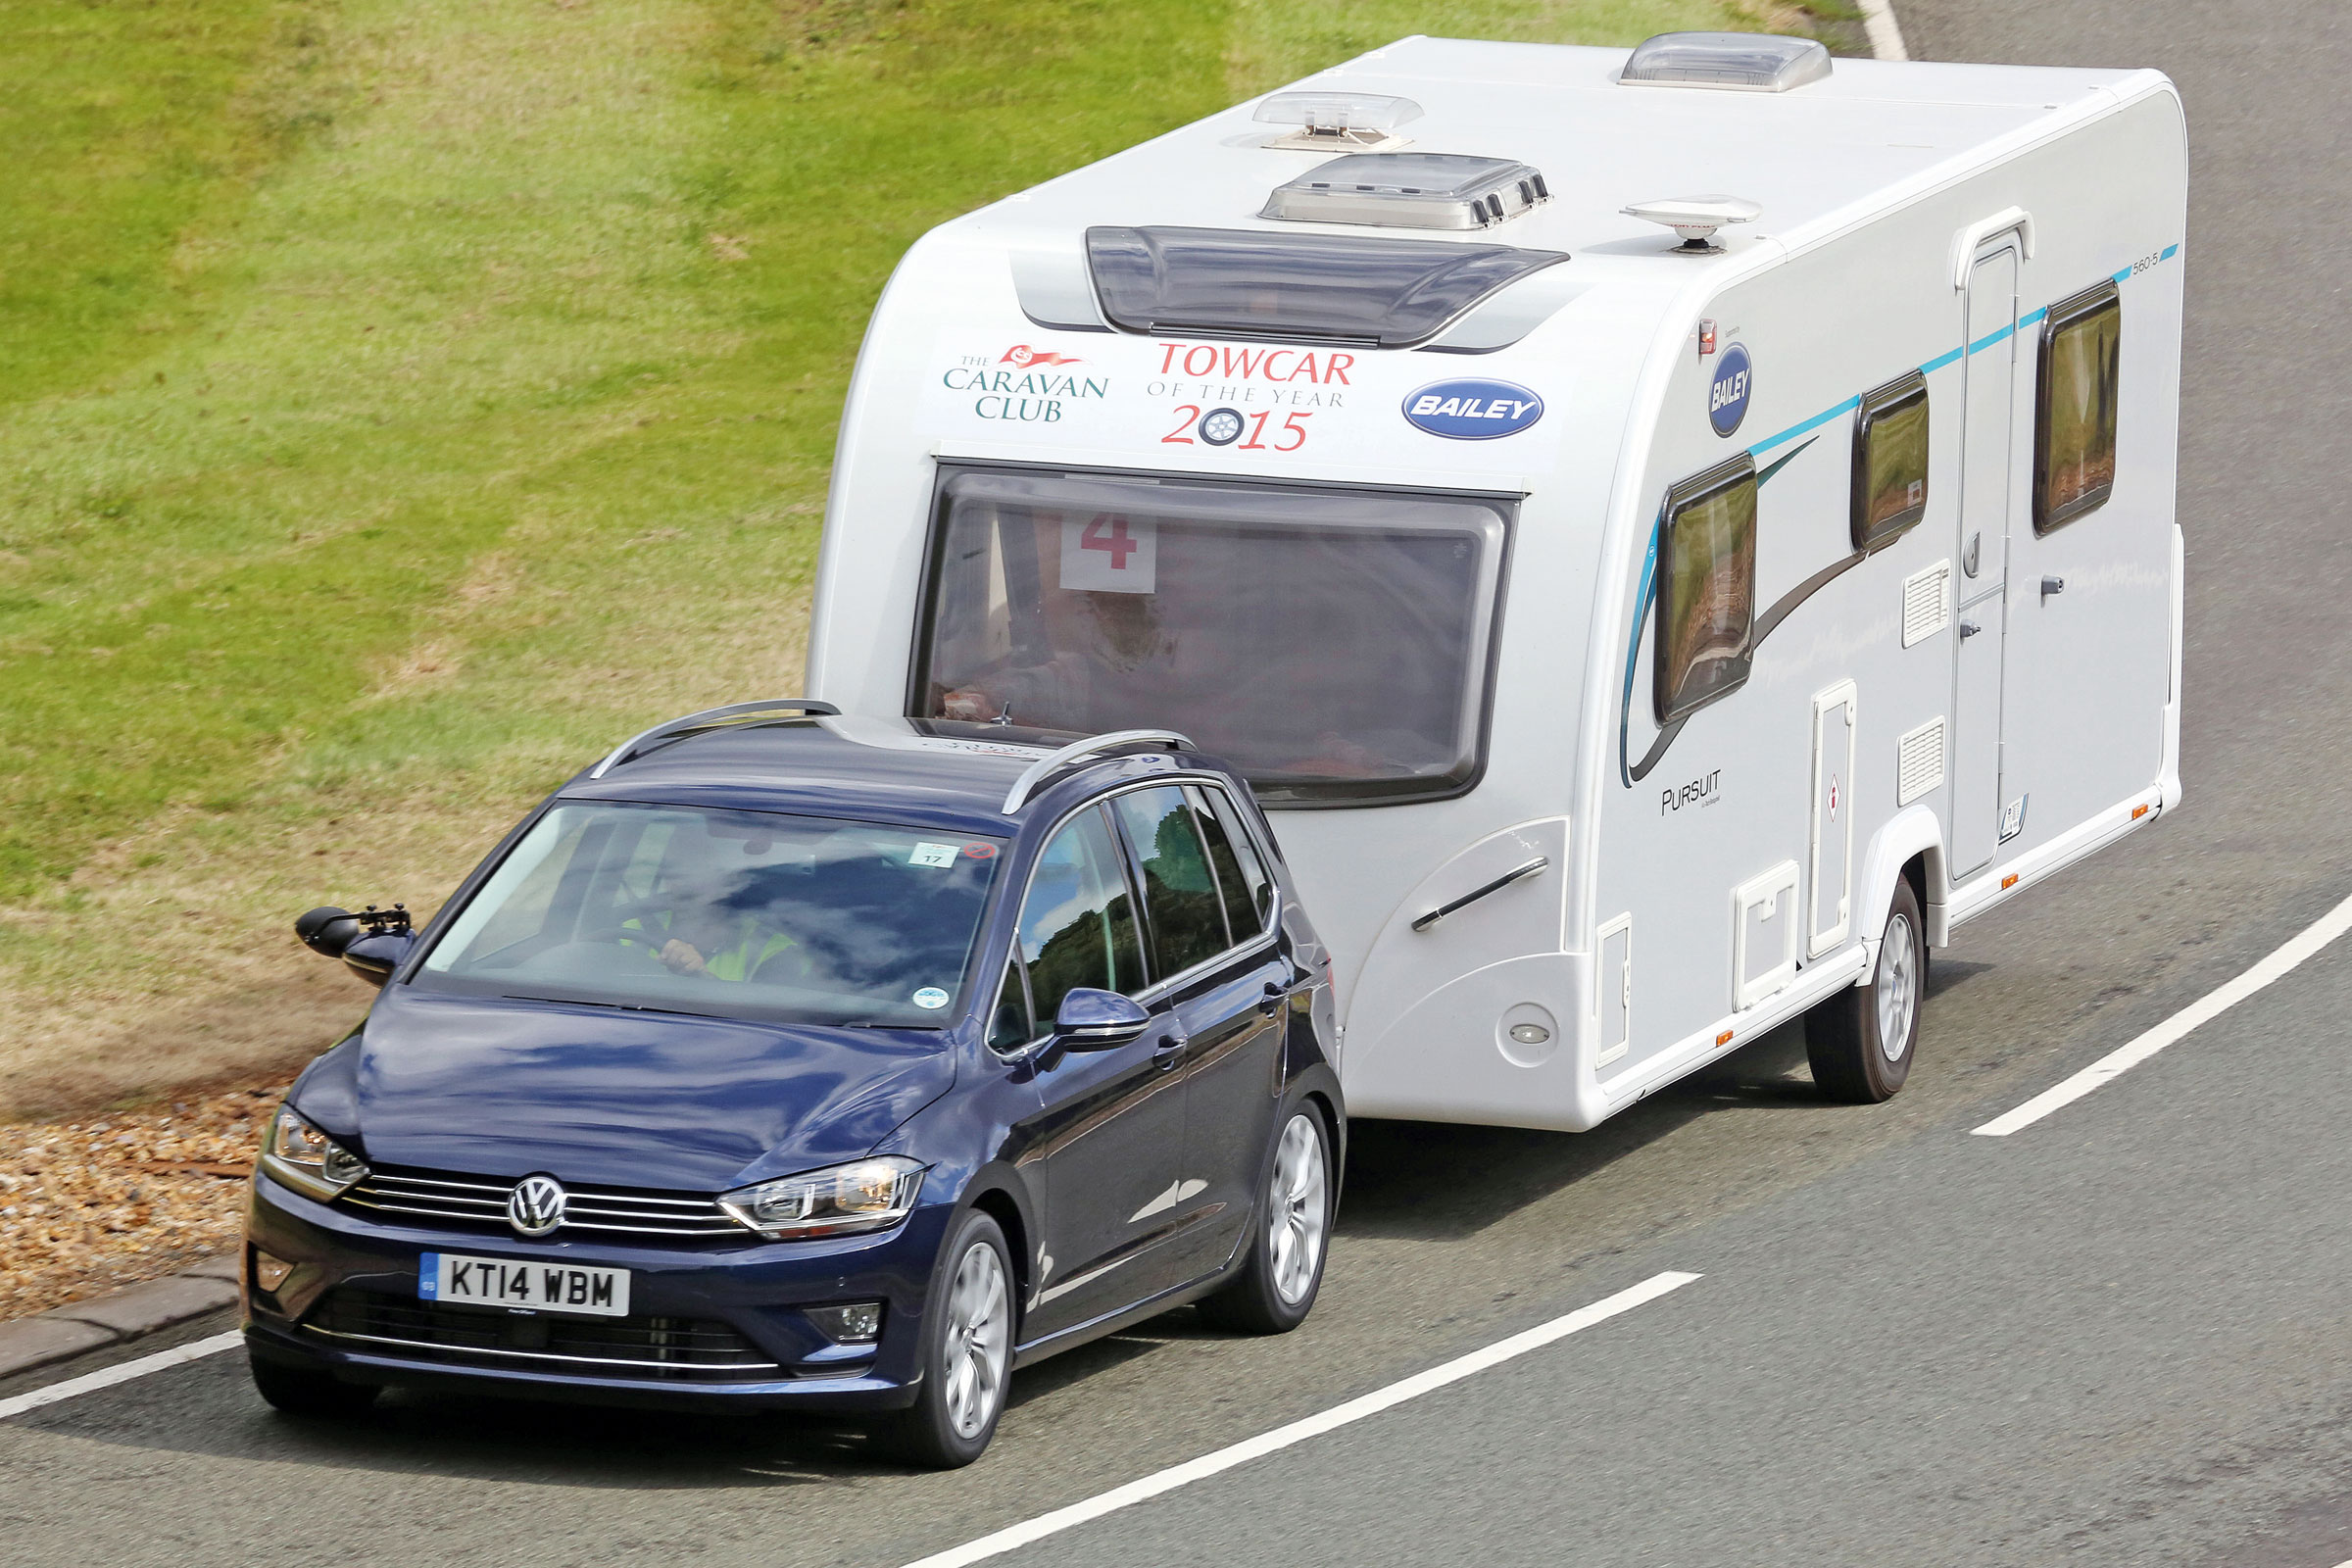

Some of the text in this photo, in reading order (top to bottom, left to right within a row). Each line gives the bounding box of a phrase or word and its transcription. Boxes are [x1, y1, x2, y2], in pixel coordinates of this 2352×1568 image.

[960, 356, 990, 367] THE
[1158, 343, 1354, 385] TOWCAR
[943, 368, 1111, 399] CARAVAN
[1147, 381, 1345, 408] OF THE YEAR
[1710, 368, 1749, 413] BAILEY
[975, 396, 1061, 423] CLUB
[1410, 395, 1537, 420] BAILEY
[1081, 511, 1137, 570] 4
[1662, 769, 1721, 816] PURSUIT
[924, 855, 942, 863] 17
[451, 1260, 613, 1307] KT14 WBM
